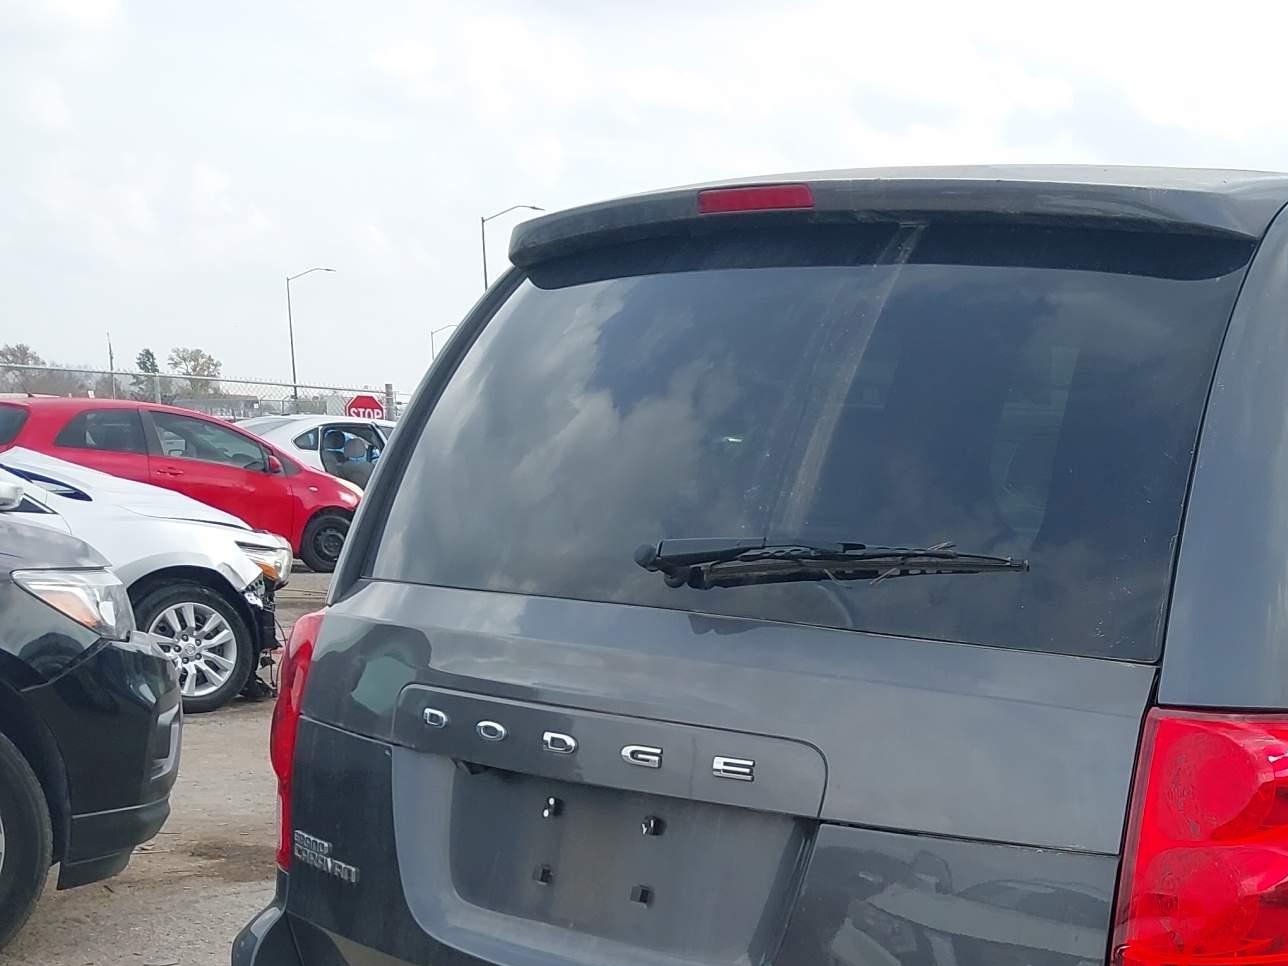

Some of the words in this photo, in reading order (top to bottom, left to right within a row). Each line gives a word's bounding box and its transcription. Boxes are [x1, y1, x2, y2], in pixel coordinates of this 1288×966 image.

[350, 407, 382, 420] STOP
[422, 706, 757, 783] DODGE
[294, 829, 331, 855] GRAND
[294, 842, 358, 883] CARAVAN
